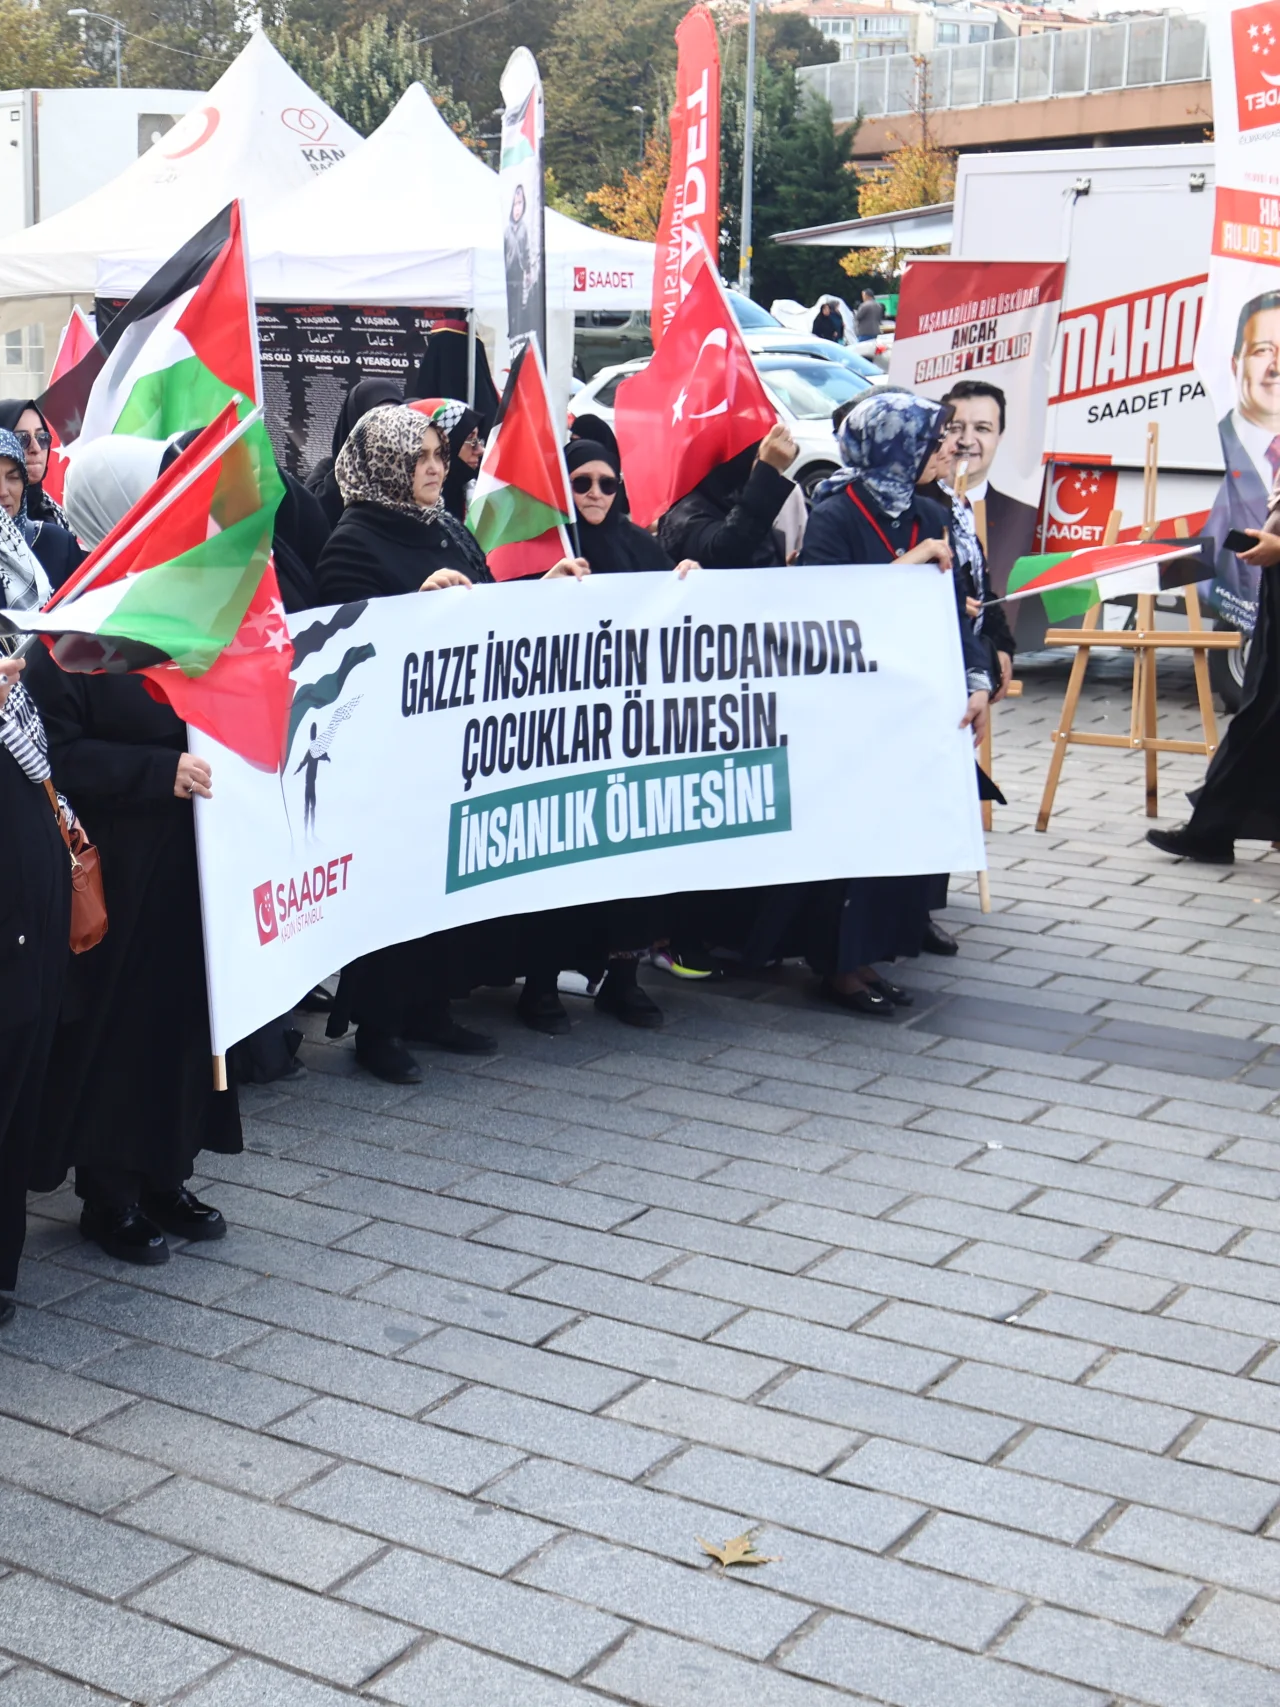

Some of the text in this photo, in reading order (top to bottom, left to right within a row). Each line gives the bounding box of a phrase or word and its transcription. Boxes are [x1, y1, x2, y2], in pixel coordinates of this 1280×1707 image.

[301, 149, 346, 162] KAN
[589, 271, 634, 289] SAADET
[302, 316, 340, 325] YAŞINDA
[919, 285, 1041, 334] YAŞANABİLİR BİR ÜSKÜDAR
[362, 317, 400, 327] YAŞINDA
[951, 319, 998, 350] ANCAK
[274, 353, 292, 362] OLD
[297, 354, 351, 365] 3 YEARS OLD
[355, 356, 409, 368] 4 YEARS OLD
[915, 332, 1032, 383] SAADET'LE OLUR
[1087, 381, 1207, 424] SAADET PA
[1036, 525, 1104, 542] SAADET
[401, 615, 877, 718] GAZZE İNSANLIĞIN VİCDANIDIR.
[461, 683, 788, 792] ÇOCUKLAR ÖLMESİN.
[458, 758, 776, 877] İNSANLIK ÖLMESİN!
[276, 853, 353, 922] SAADET
